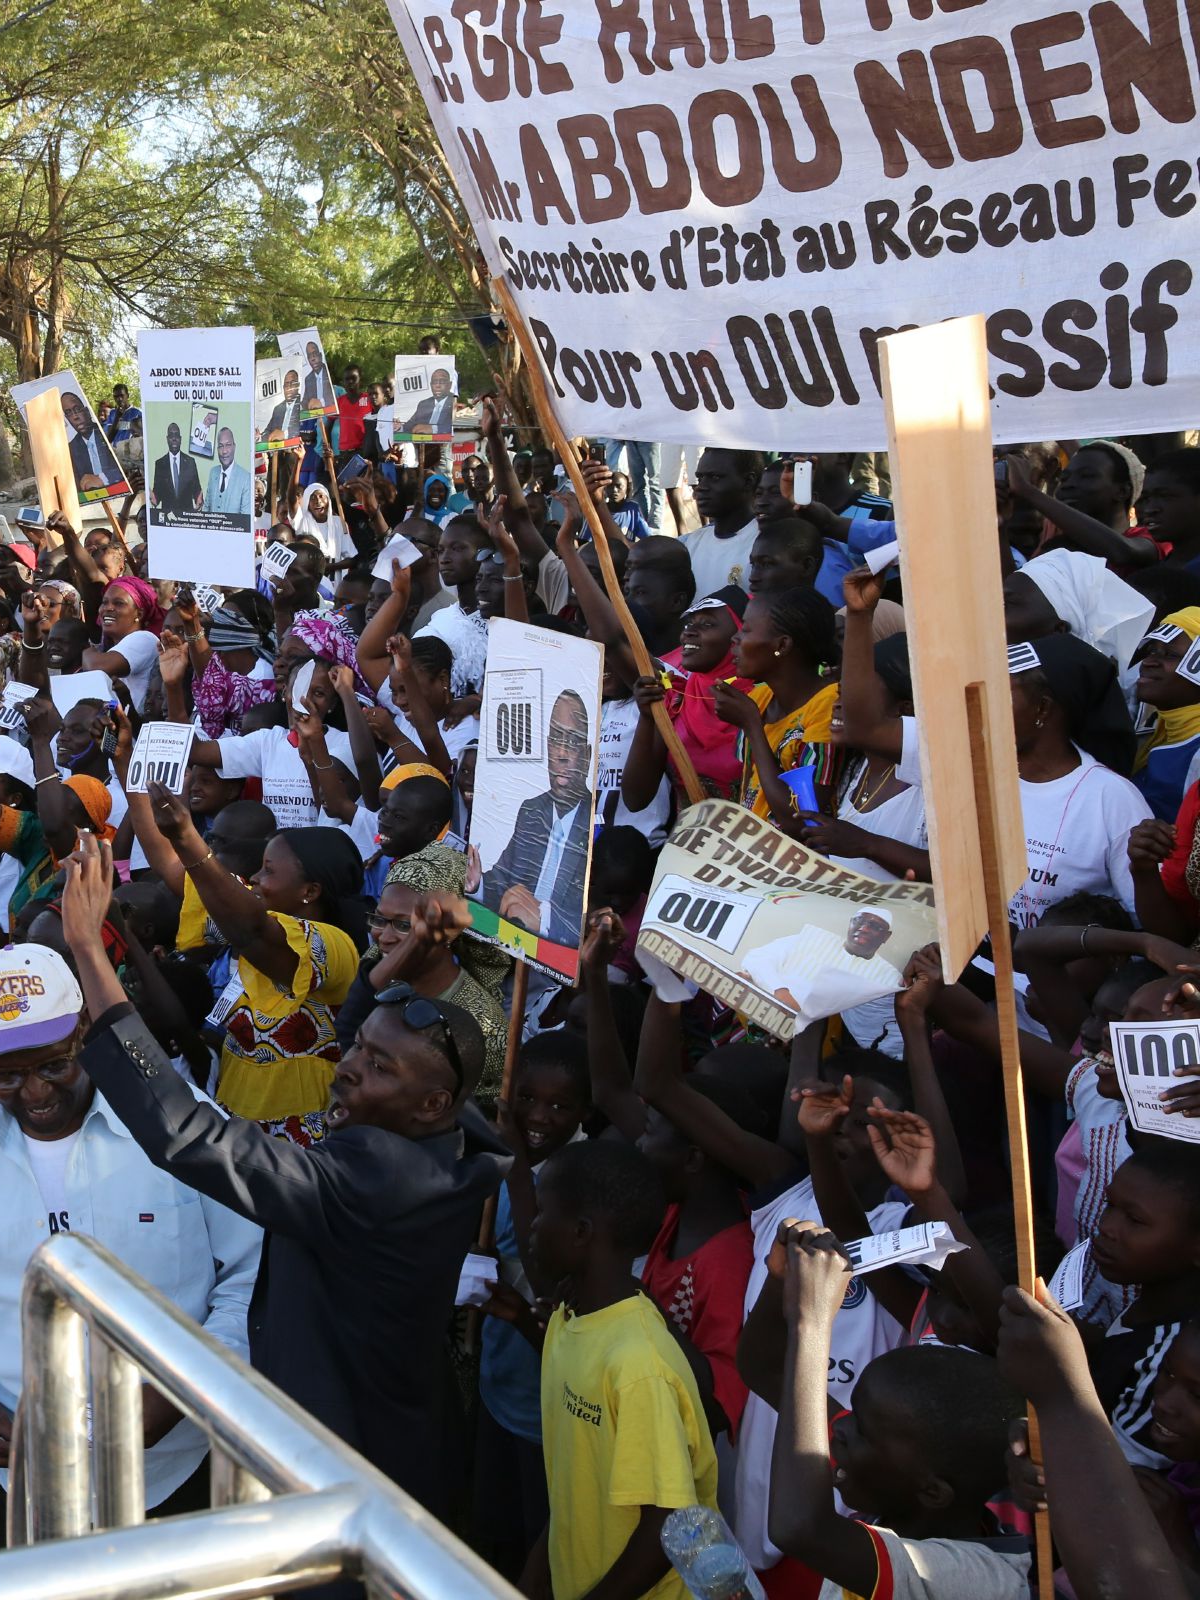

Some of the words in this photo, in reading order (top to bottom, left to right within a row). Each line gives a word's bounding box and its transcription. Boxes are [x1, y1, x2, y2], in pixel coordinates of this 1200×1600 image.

[451, 0, 574, 102] GIE
[519, 74, 842, 226] ABDOU
[854, 0, 1200, 179] NDEN
[499, 236, 656, 295] Secretaire
[660, 218, 786, 290] d'Etat
[793, 220, 857, 273] au
[865, 177, 1096, 265] Réseau
[1113, 154, 1200, 228] Fe
[529, 317, 642, 410] Pour
[651, 350, 735, 412] un
[726, 306, 860, 410] OUI
[860, 259, 1193, 399] ssif
[150, 368, 182, 377] ABDOU
[184, 367, 216, 377] NDENE
[218, 367, 242, 376] SALL
[262, 380, 278, 397] OUI
[403, 375, 423, 391] OUI
[174, 390, 190, 402] OUI,
[192, 390, 208, 401] OUI,
[209, 390, 224, 400] OUI
[267, 546, 291, 567] OUI
[496, 703, 532, 756] OUI
[147, 761, 179, 788] OUI
[598, 768, 623, 788] VOTE
[687, 804, 936, 908] DEPARTEMEN
[1027, 838, 1068, 854] SENEGAL
[667, 828, 713, 855] DE
[712, 838, 887, 905] TIVAOUANE
[693, 863, 758, 893] DIT
[657, 892, 735, 941] OUI
[213, 997, 232, 1021] OUI
[679, 955, 745, 1004] NOTRE
[739, 995, 795, 1038] DEMO
[1123, 1032, 1198, 1077] OUI
[1059, 1255, 1072, 1305] REFERENDUM
[578, 1396, 602, 1414] South
